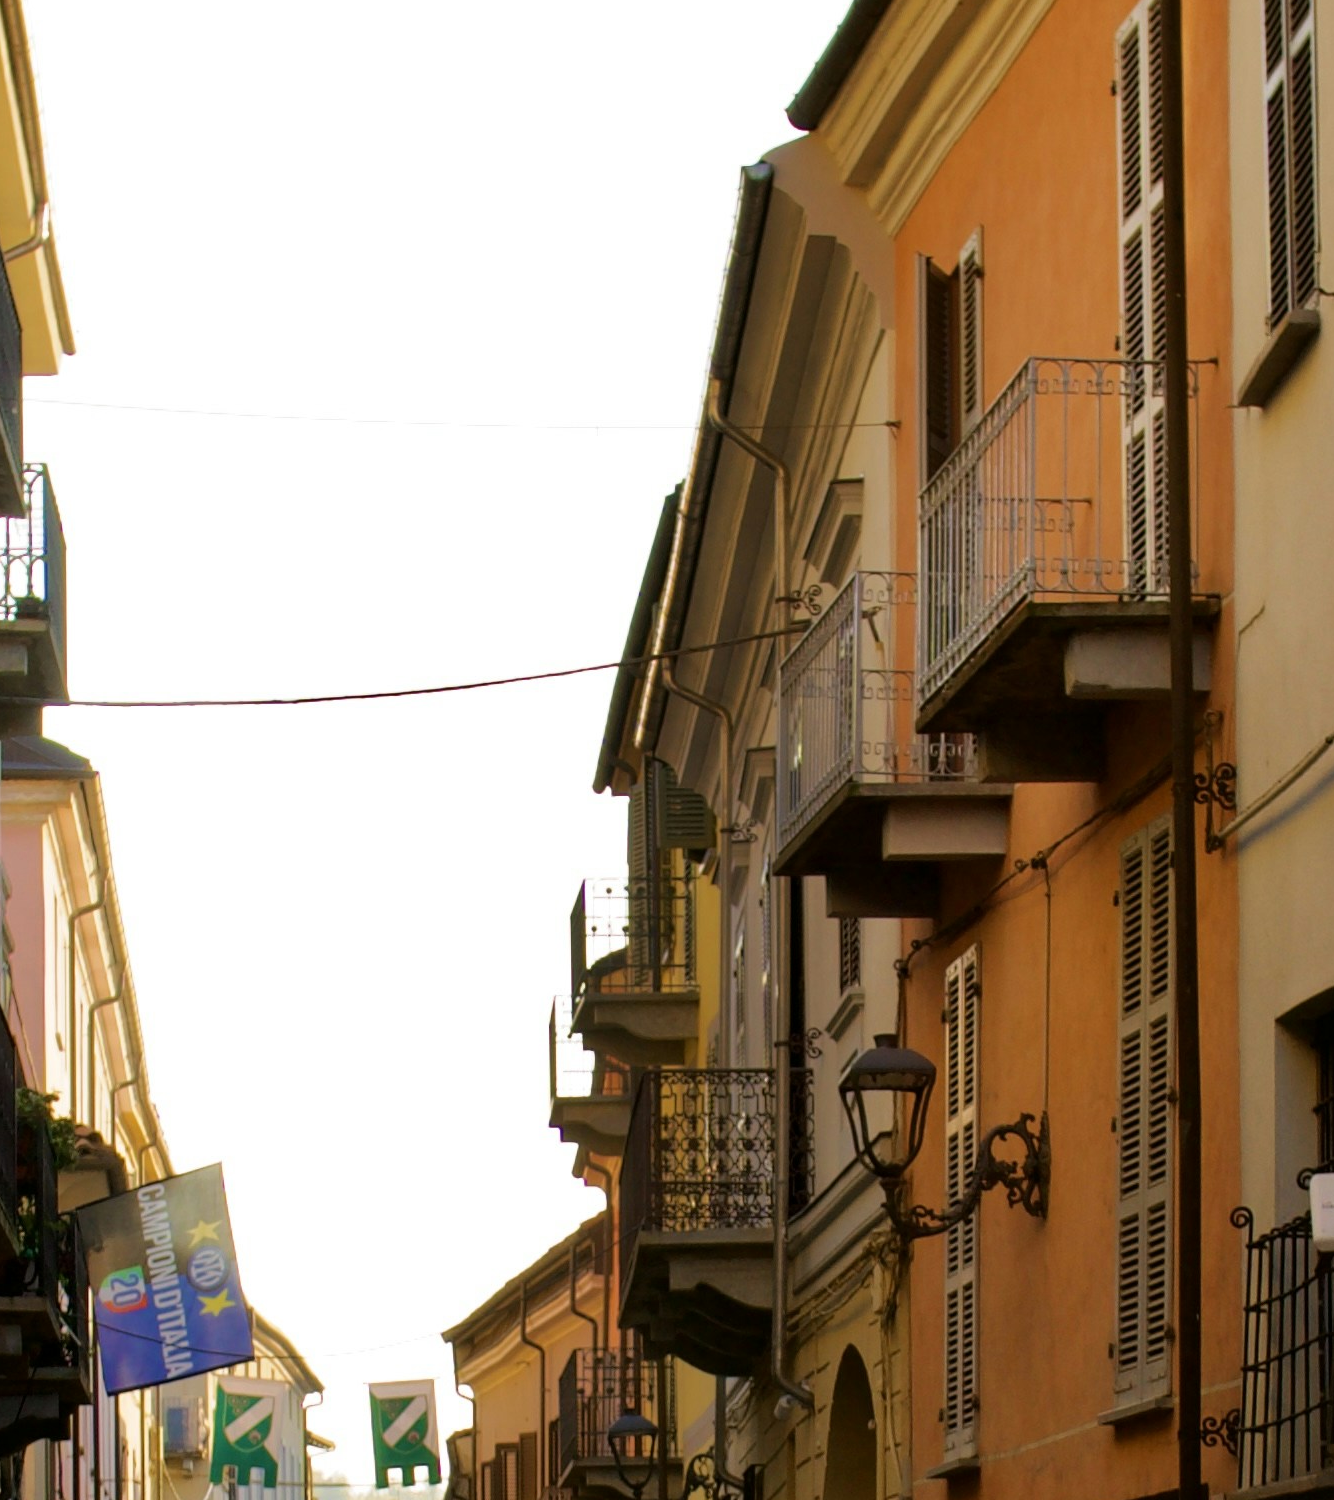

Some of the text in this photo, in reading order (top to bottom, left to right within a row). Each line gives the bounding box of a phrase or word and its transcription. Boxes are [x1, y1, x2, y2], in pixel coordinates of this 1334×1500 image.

[110, 1274, 141, 1307] 20
[136, 1183, 194, 1379] CAMPIONI D'ITALIA
